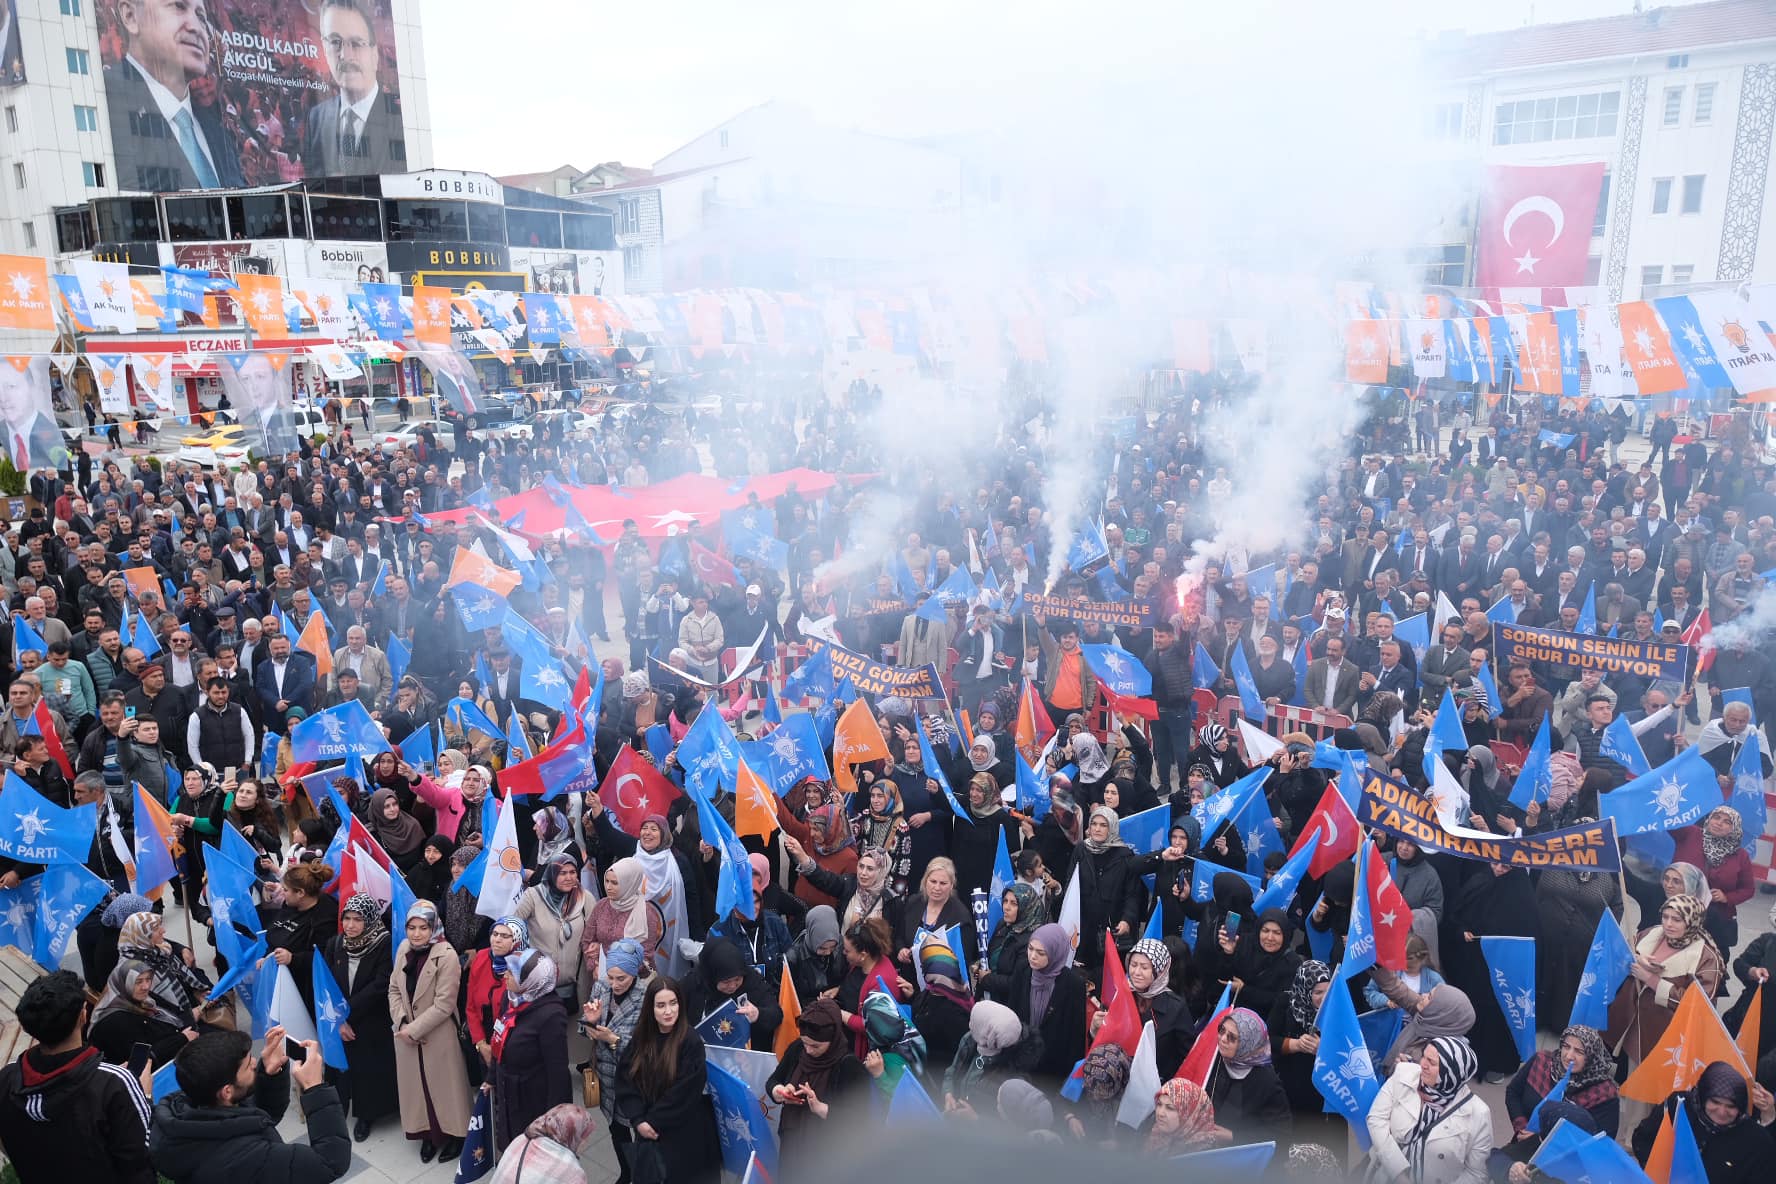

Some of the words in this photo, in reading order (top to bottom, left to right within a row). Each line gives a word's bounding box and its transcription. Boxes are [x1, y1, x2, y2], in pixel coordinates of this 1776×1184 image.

[221, 30, 319, 59] ABDULKADİR
[223, 50, 276, 72] AKGÜL
[224, 67, 257, 81] Yozgat
[257, 74, 304, 88] Milletvekili
[305, 80, 330, 92] Adayı
[321, 249, 364, 262] Bobbili
[189, 339, 242, 352] ECZANE
[1073, 610, 1140, 625] DUYUYOR
[1502, 628, 1578, 650] SORGUN
[1583, 640, 1640, 658] SENİN
[1646, 643, 1678, 662] İLE
[1513, 644, 1563, 664] GRUR
[1567, 653, 1662, 677] DUYUYOR
[1369, 799, 1501, 860] YAZDIRAN
[1511, 848, 1599, 866] ADAM
